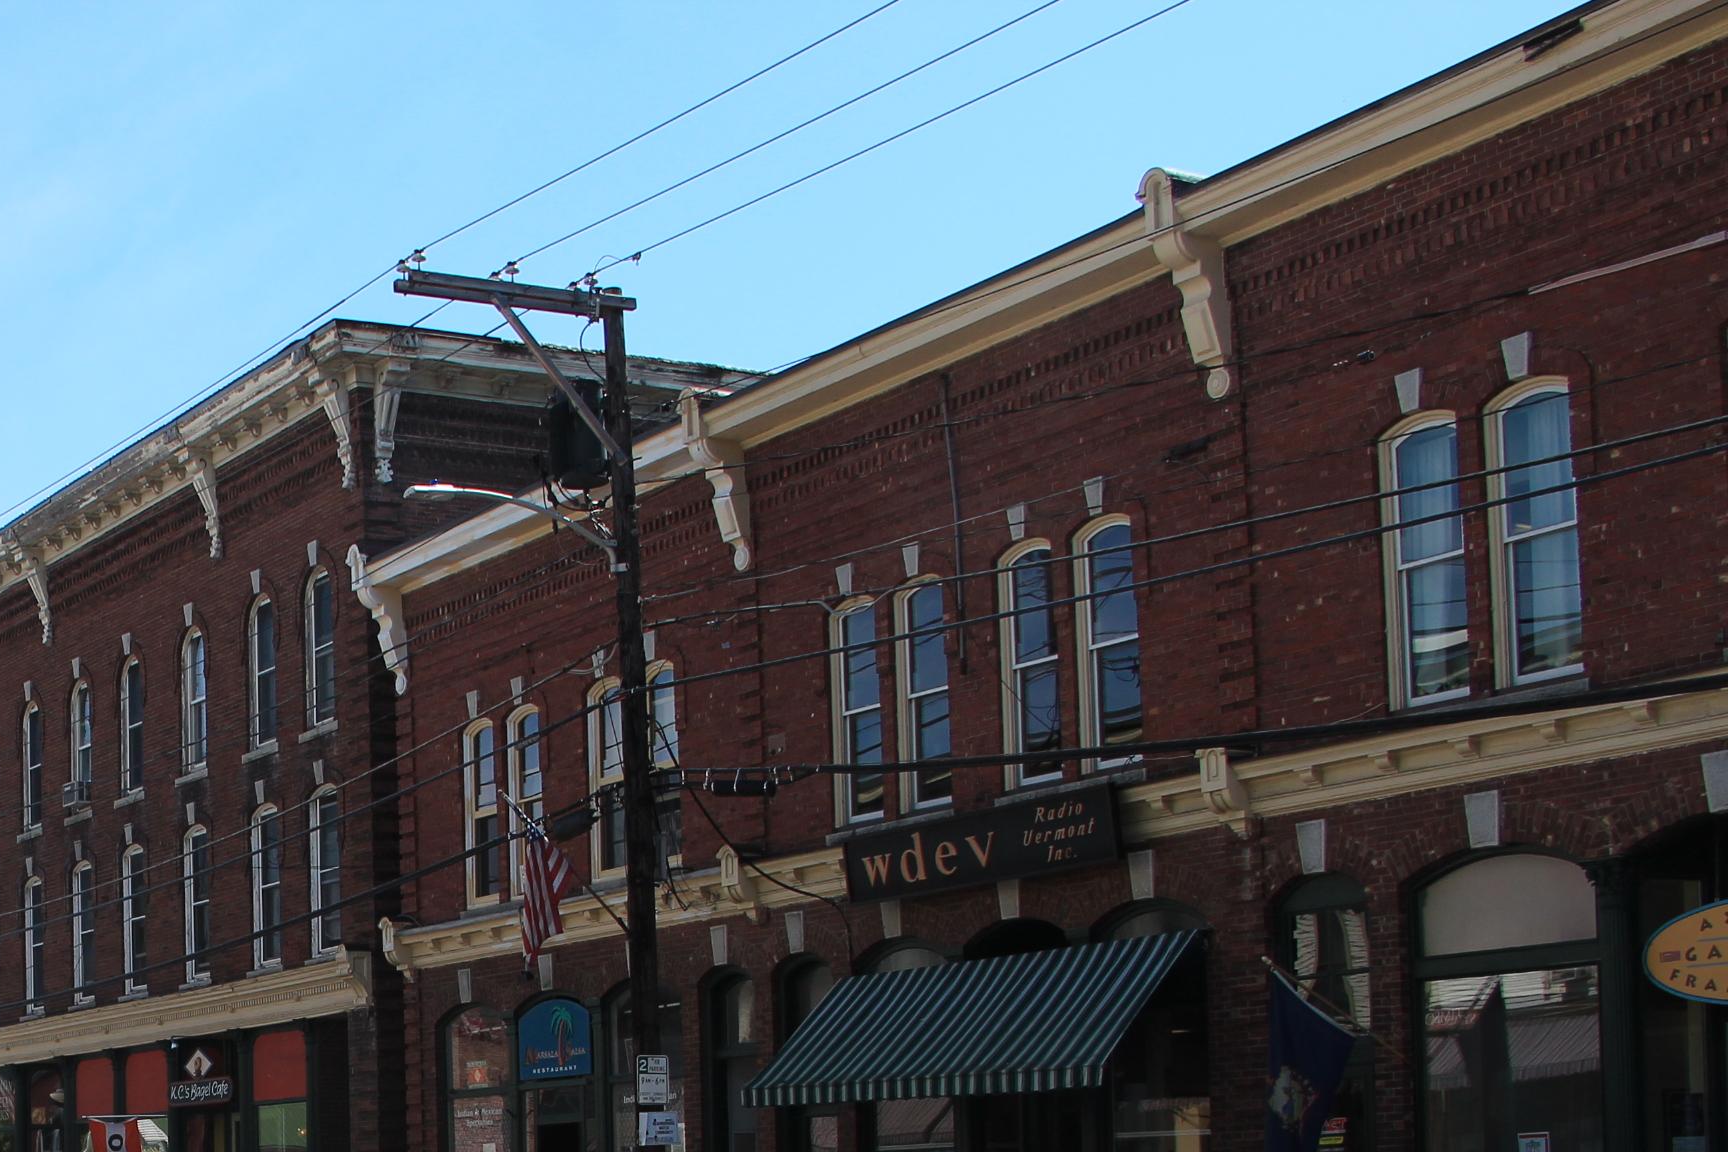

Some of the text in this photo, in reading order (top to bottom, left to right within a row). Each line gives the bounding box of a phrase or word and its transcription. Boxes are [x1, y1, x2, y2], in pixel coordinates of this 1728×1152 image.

[1034, 800, 1085, 823] Radio
[1023, 818, 1096, 847] Vermont
[860, 831, 996, 889] wdev
[1047, 844, 1078, 864] Inc.
[1670, 969, 1728, 991] FRA
[532, 1065, 577, 1074] RESTAURANT
[639, 1059, 648, 1072] 2
[190, 1082, 211, 1101] Bagel
[211, 1080, 229, 1099] Cafe
